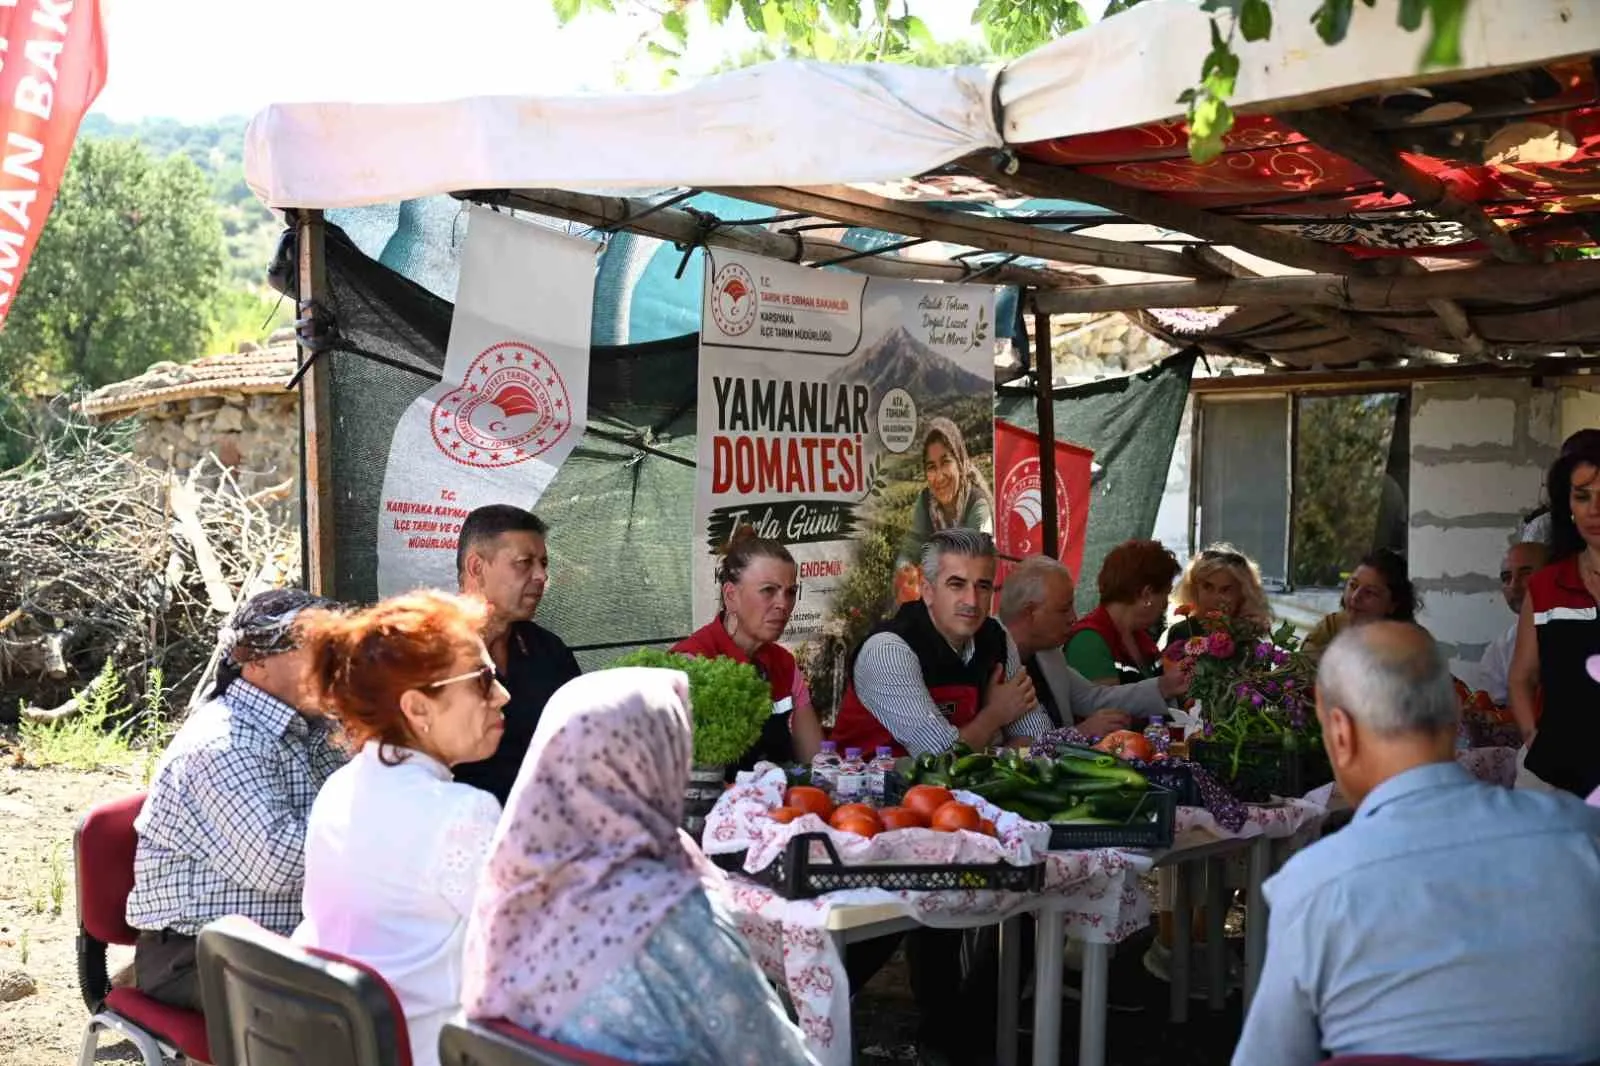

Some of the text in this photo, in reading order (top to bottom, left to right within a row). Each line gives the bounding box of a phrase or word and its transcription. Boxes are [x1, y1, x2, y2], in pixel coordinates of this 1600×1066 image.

[760, 292, 781, 304] TARIM
[782, 294, 791, 305] VE
[792, 295, 815, 308] ORMAN
[760, 312, 795, 325] KARŞIYAKA
[775, 328, 794, 340] TARIM
[794, 328, 833, 343] MÜDÜRLÜĞÜ
[712, 376, 869, 433] YAMANLAR
[712, 433, 864, 494] DOMATESİ
[385, 500, 470, 518] KARŞIYAKA KAYMA
[393, 519, 411, 537] İLÇE
[411, 519, 438, 532] TARIM
[439, 522, 452, 534] VE
[728, 504, 841, 543] Trla Günü
